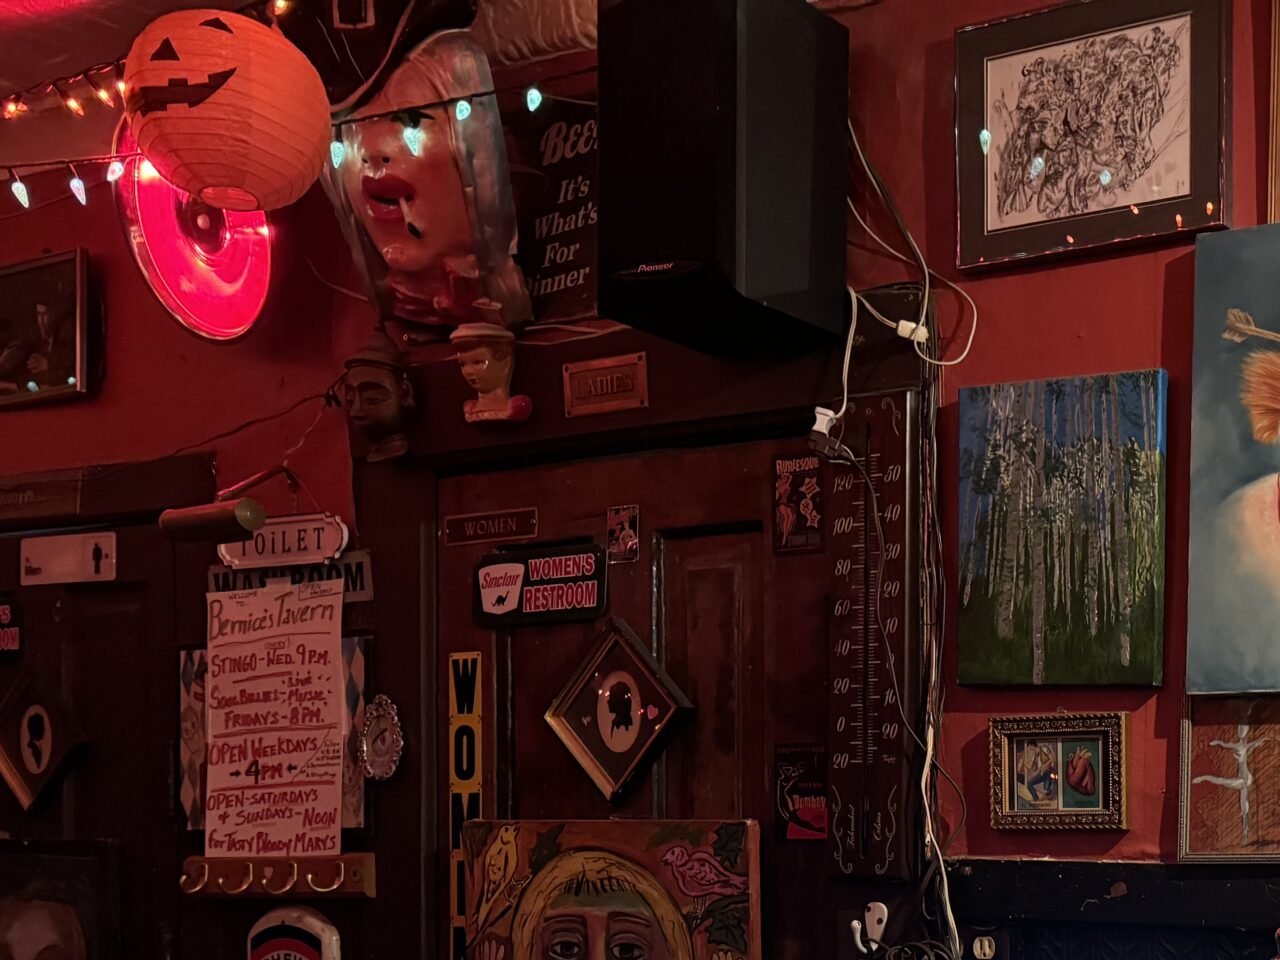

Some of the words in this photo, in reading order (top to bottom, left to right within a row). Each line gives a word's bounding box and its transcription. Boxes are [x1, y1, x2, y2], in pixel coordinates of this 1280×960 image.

[559, 176, 590, 205] It's
[533, 202, 598, 242] What's
[542, 240, 580, 269] For
[637, 261, 674, 273] Pioneer
[575, 373, 634, 398] LADIES
[833, 473, 853, 493] 120
[884, 465, 900, 482] 50
[884, 504, 900, 522] 40
[464, 517, 517, 536] WOMEN
[833, 517, 853, 536] 100
[884, 543, 900, 560] 30
[528, 553, 595, 581] WOMEN'S
[835, 559, 850, 576] 80
[213, 562, 365, 592] WASROOM
[481, 572, 520, 590] Sinclair
[523, 580, 597, 613] RESTROOM
[884, 581, 899, 597] 20
[209, 599, 274, 641] Bernice's
[275, 592, 334, 627] Tavern
[835, 600, 850, 616] 60
[296, 644, 305, 665] 9
[834, 639, 850, 656] 40
[833, 678, 849, 694] 20
[836, 716, 845, 732] 0
[882, 723, 898, 739] 20
[209, 739, 247, 765] OPEN
[252, 737, 317, 759] WEEKDAYS
[833, 753, 848, 769] 20
[303, 808, 337, 827] NOON
